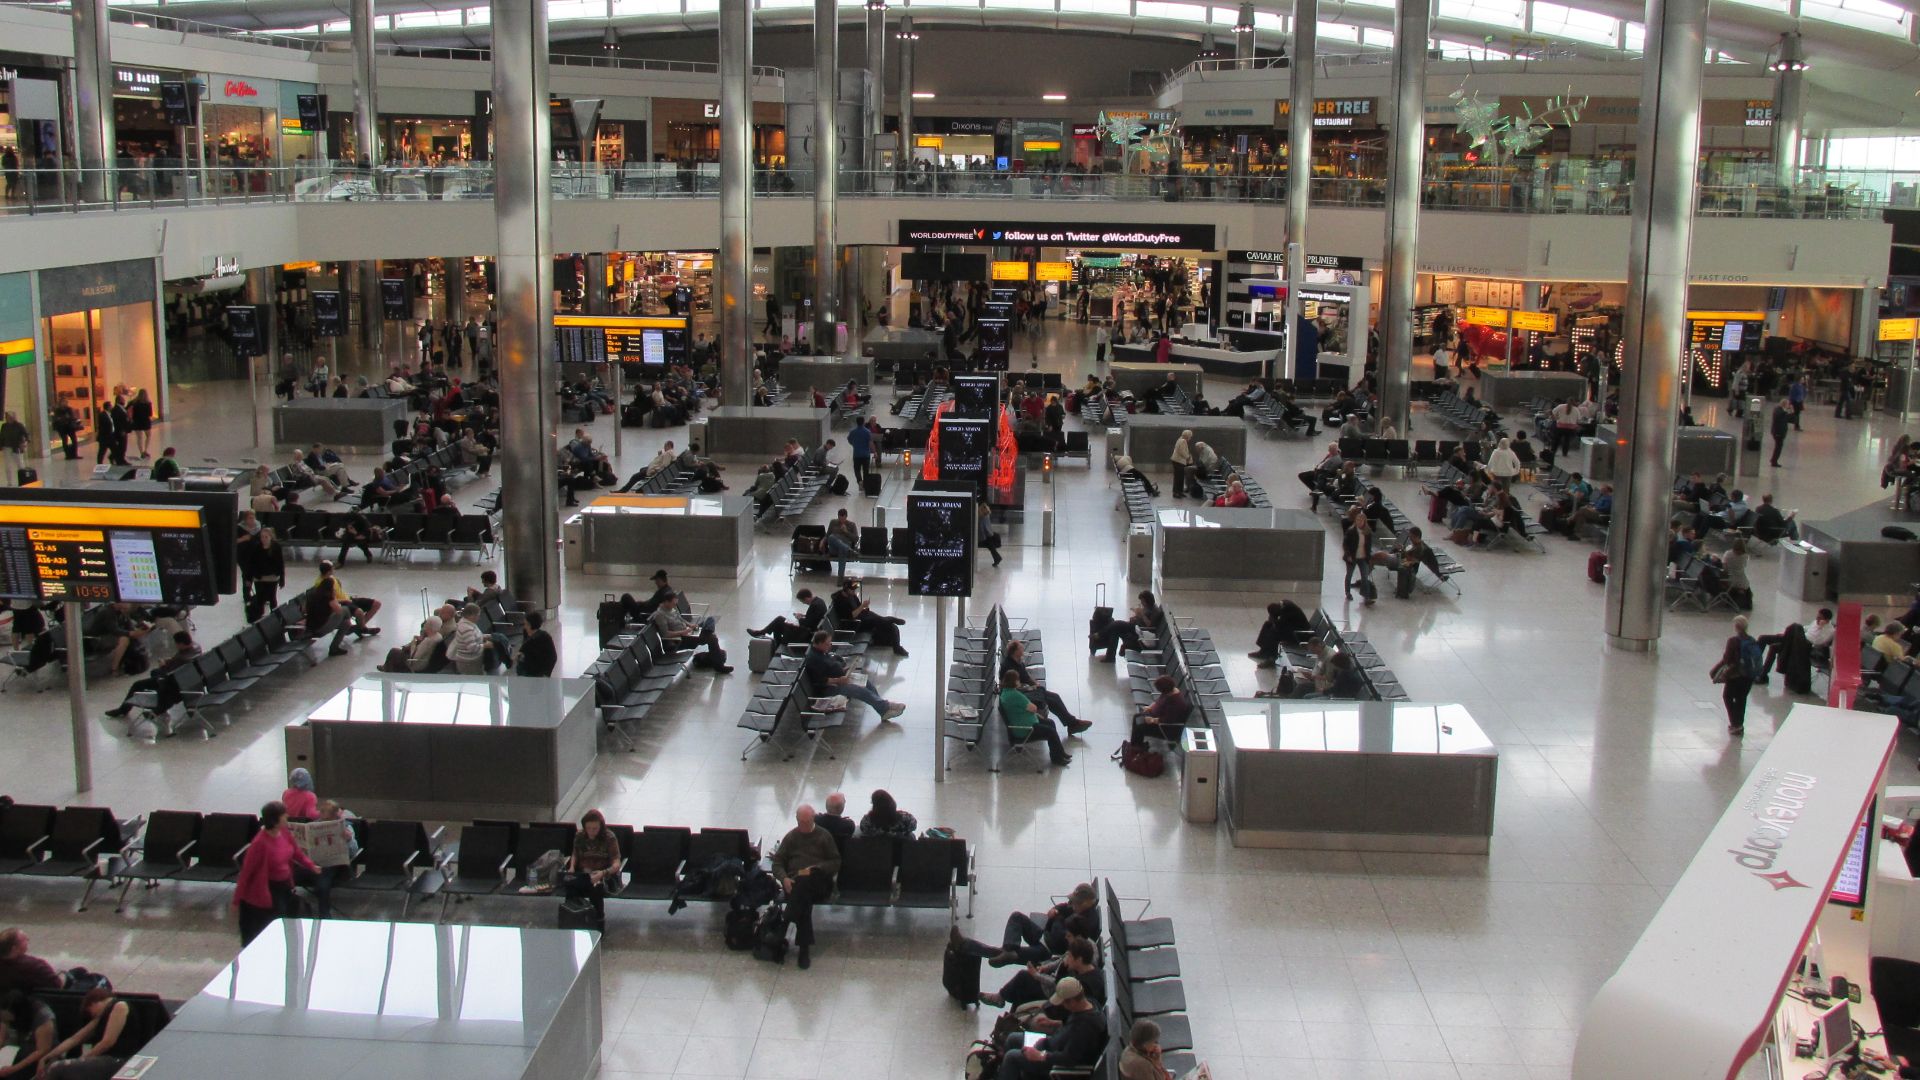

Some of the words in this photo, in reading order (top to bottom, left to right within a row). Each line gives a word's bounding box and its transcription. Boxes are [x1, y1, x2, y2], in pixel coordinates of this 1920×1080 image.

[118, 72, 133, 82] TED
[136, 73, 160, 84] BAKER
[1746, 109, 1772, 119] TRE
[1314, 118, 1352, 126] RESTAURANT
[1004, 231, 1034, 241] follow
[1066, 232, 1099, 242] Twitter
[1102, 233, 1180, 244] @WorldDutyFree
[1246, 251, 1273, 261] CAVIAR
[1307, 255, 1339, 265] PRUNIER
[1298, 290, 1322, 301] Currency
[1323, 293, 1350, 302] Exchange
[76, 584, 109, 597] 10:59
[1727, 771, 1817, 870] moneycorp
